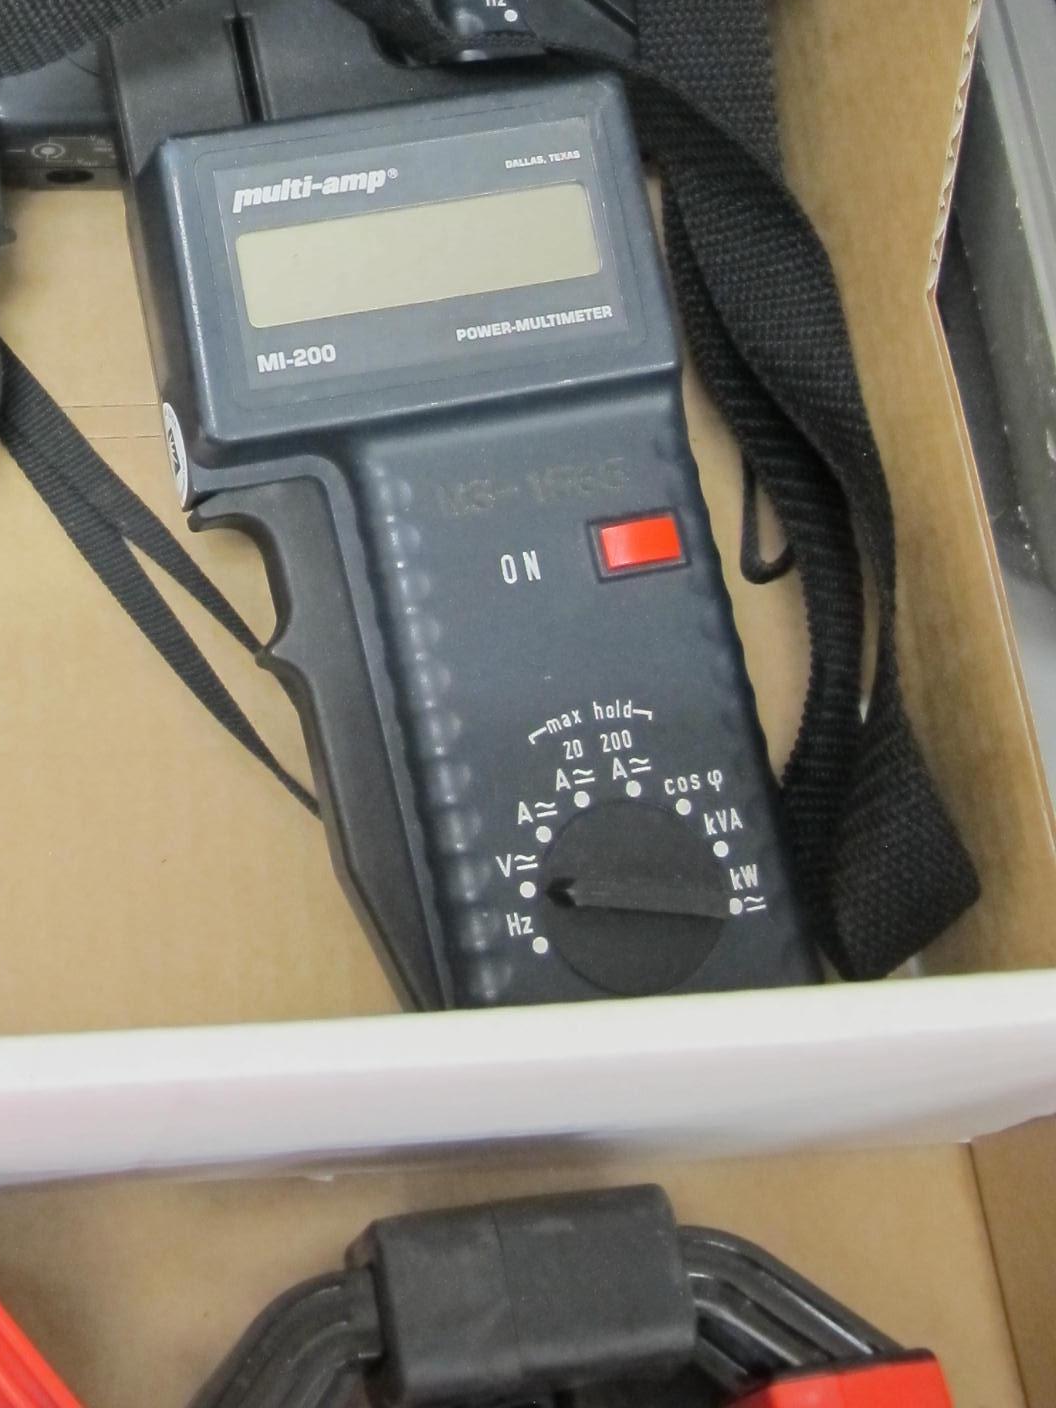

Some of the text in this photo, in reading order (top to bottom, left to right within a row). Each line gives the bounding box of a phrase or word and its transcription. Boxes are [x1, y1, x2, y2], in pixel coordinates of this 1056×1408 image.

[549, 150, 581, 162] TEXAS
[232, 167, 386, 213] multi-amp
[456, 304, 613, 342] POWER-MULTIMETER
[257, 343, 337, 374] MI-200
[500, 550, 541, 585] ON
[545, 699, 632, 734] max hold
[562, 729, 633, 760] 20 200
[664, 774, 701, 796] cos
[703, 807, 744, 835] kVA
[729, 863, 759, 891] kW
[505, 911, 535, 937] Hz
